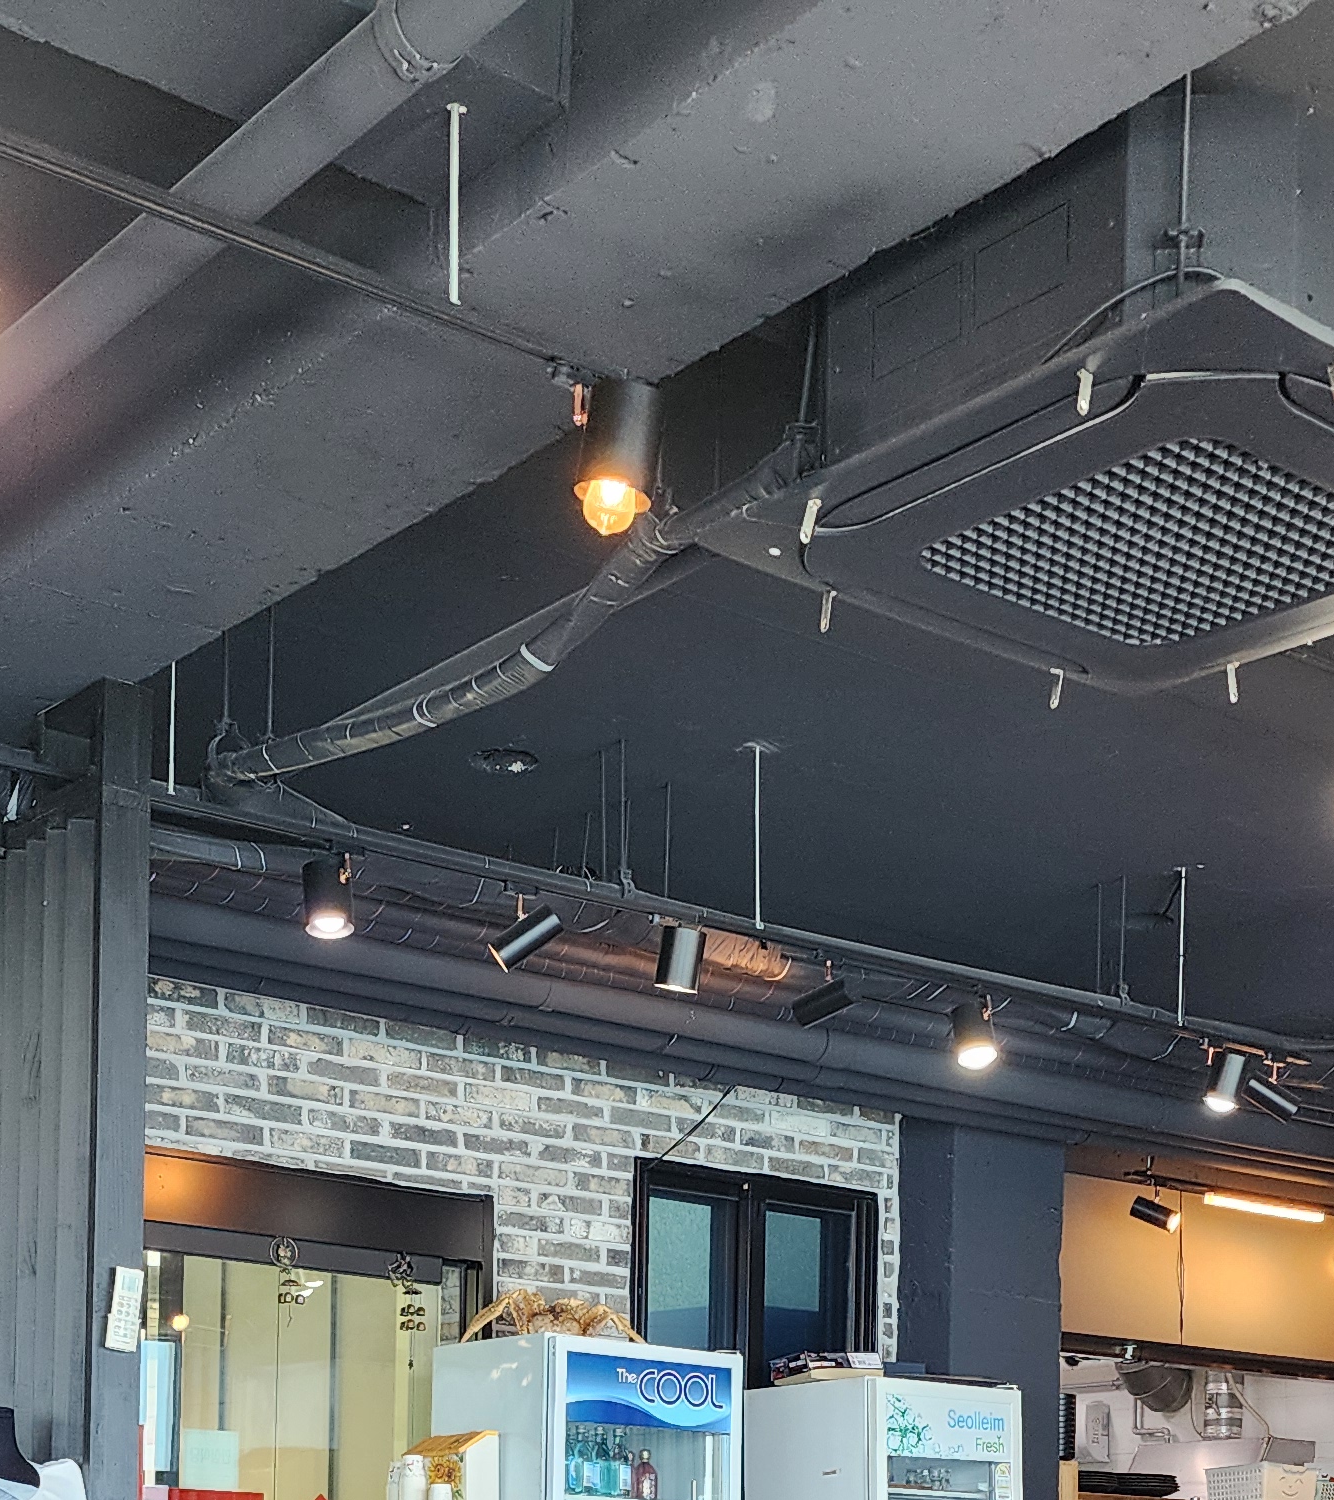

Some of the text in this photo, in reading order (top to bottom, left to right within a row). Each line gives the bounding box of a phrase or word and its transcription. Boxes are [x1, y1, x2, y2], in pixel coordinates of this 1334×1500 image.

[616, 1367, 725, 1411] The COOL
[947, 1409, 1005, 1432] Seolleim
[975, 1434, 1005, 1454] Fresh
